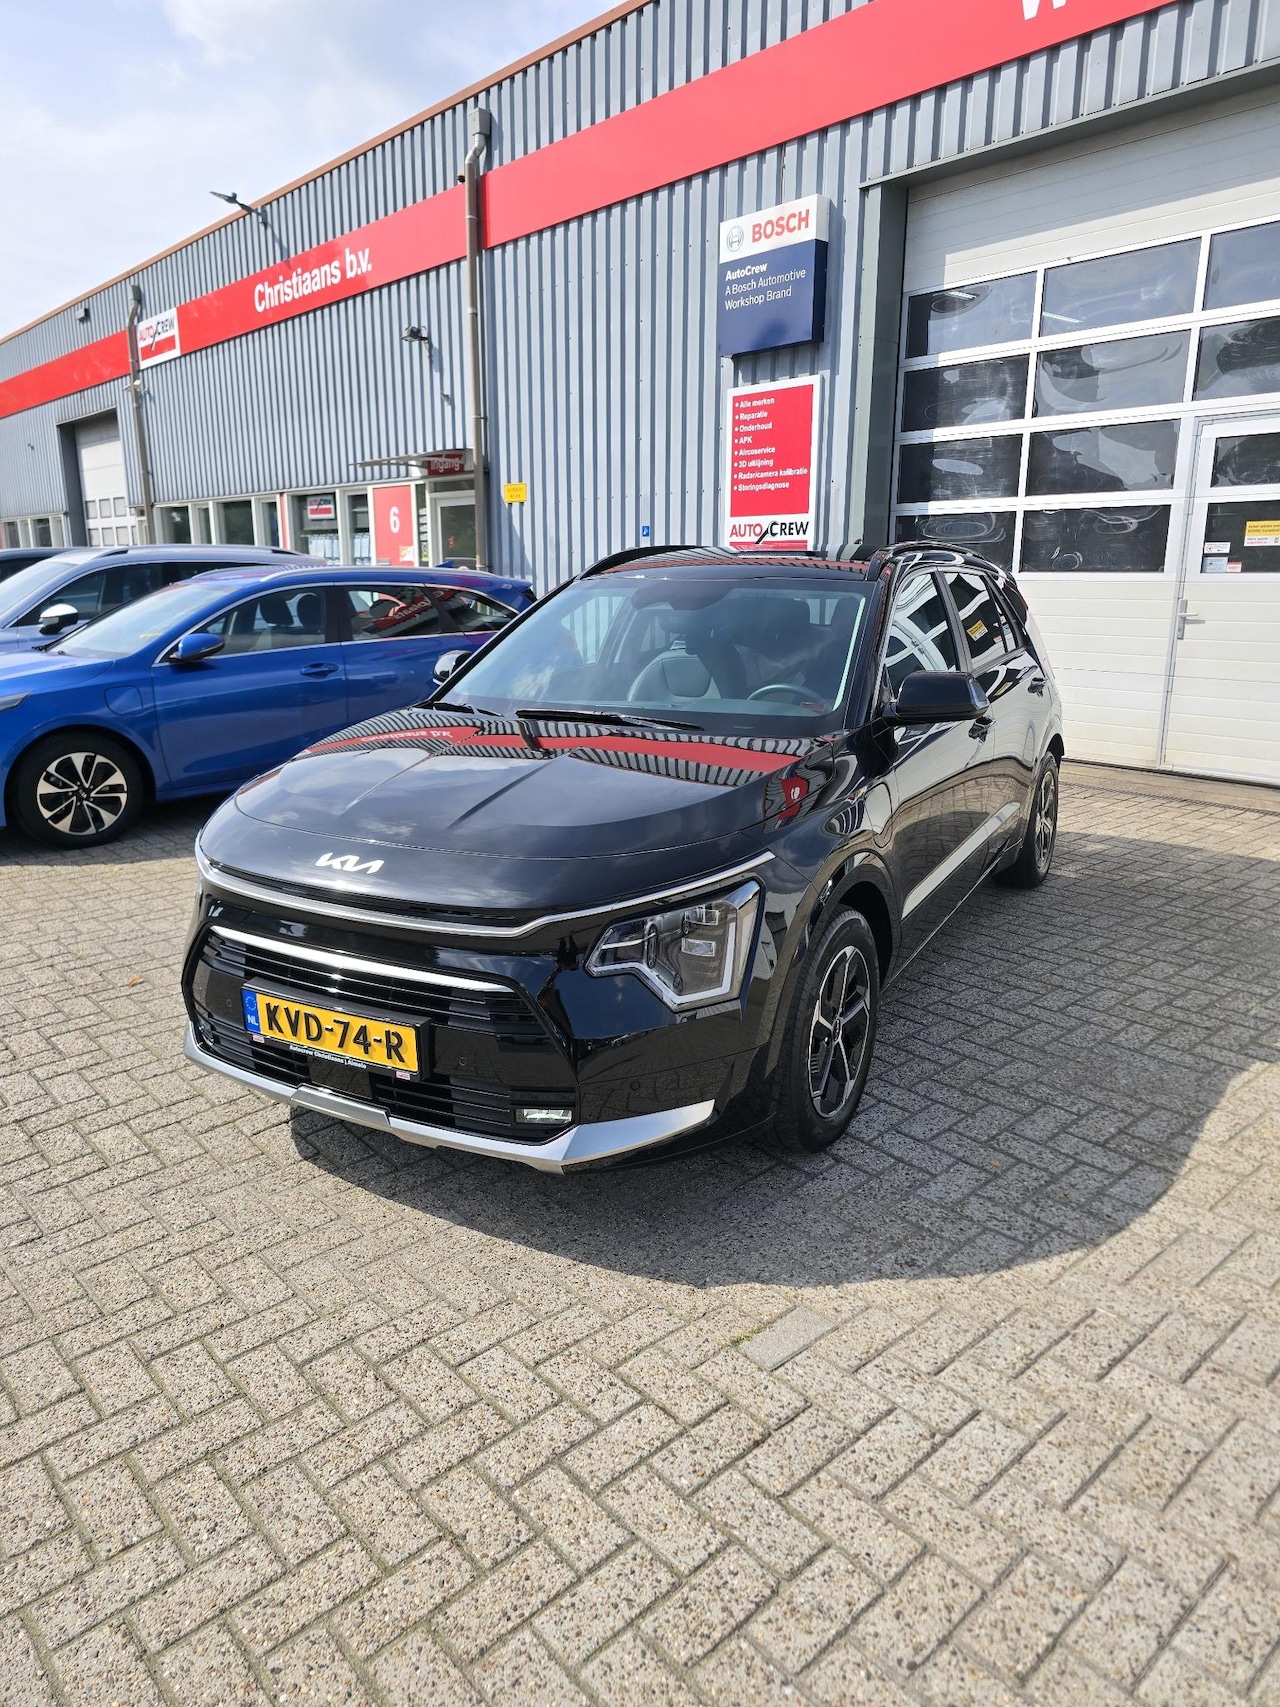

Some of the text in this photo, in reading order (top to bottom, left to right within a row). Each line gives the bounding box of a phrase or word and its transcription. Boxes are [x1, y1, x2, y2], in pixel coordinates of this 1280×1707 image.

[752, 209, 810, 243] BOSCH
[725, 263, 768, 281] AutoCrew
[254, 248, 372, 313] Christiaans b.v.
[725, 269, 806, 296] A Bosch Automotive
[725, 286, 792, 310] Workshop Brand
[740, 397, 775, 408] Alle merken
[739, 410, 768, 421] Reparatie
[739, 422, 773, 432] Onderhoud
[739, 436, 753, 444] APK
[739, 446, 776, 456] Aircoservice
[779, 467, 808, 477] kalibratie
[738, 481, 790, 492] Storingsdiagnose
[389, 506, 401, 534] 6
[247, 1015, 259, 1026] NL
[266, 1002, 405, 1063] KVD-74-R
